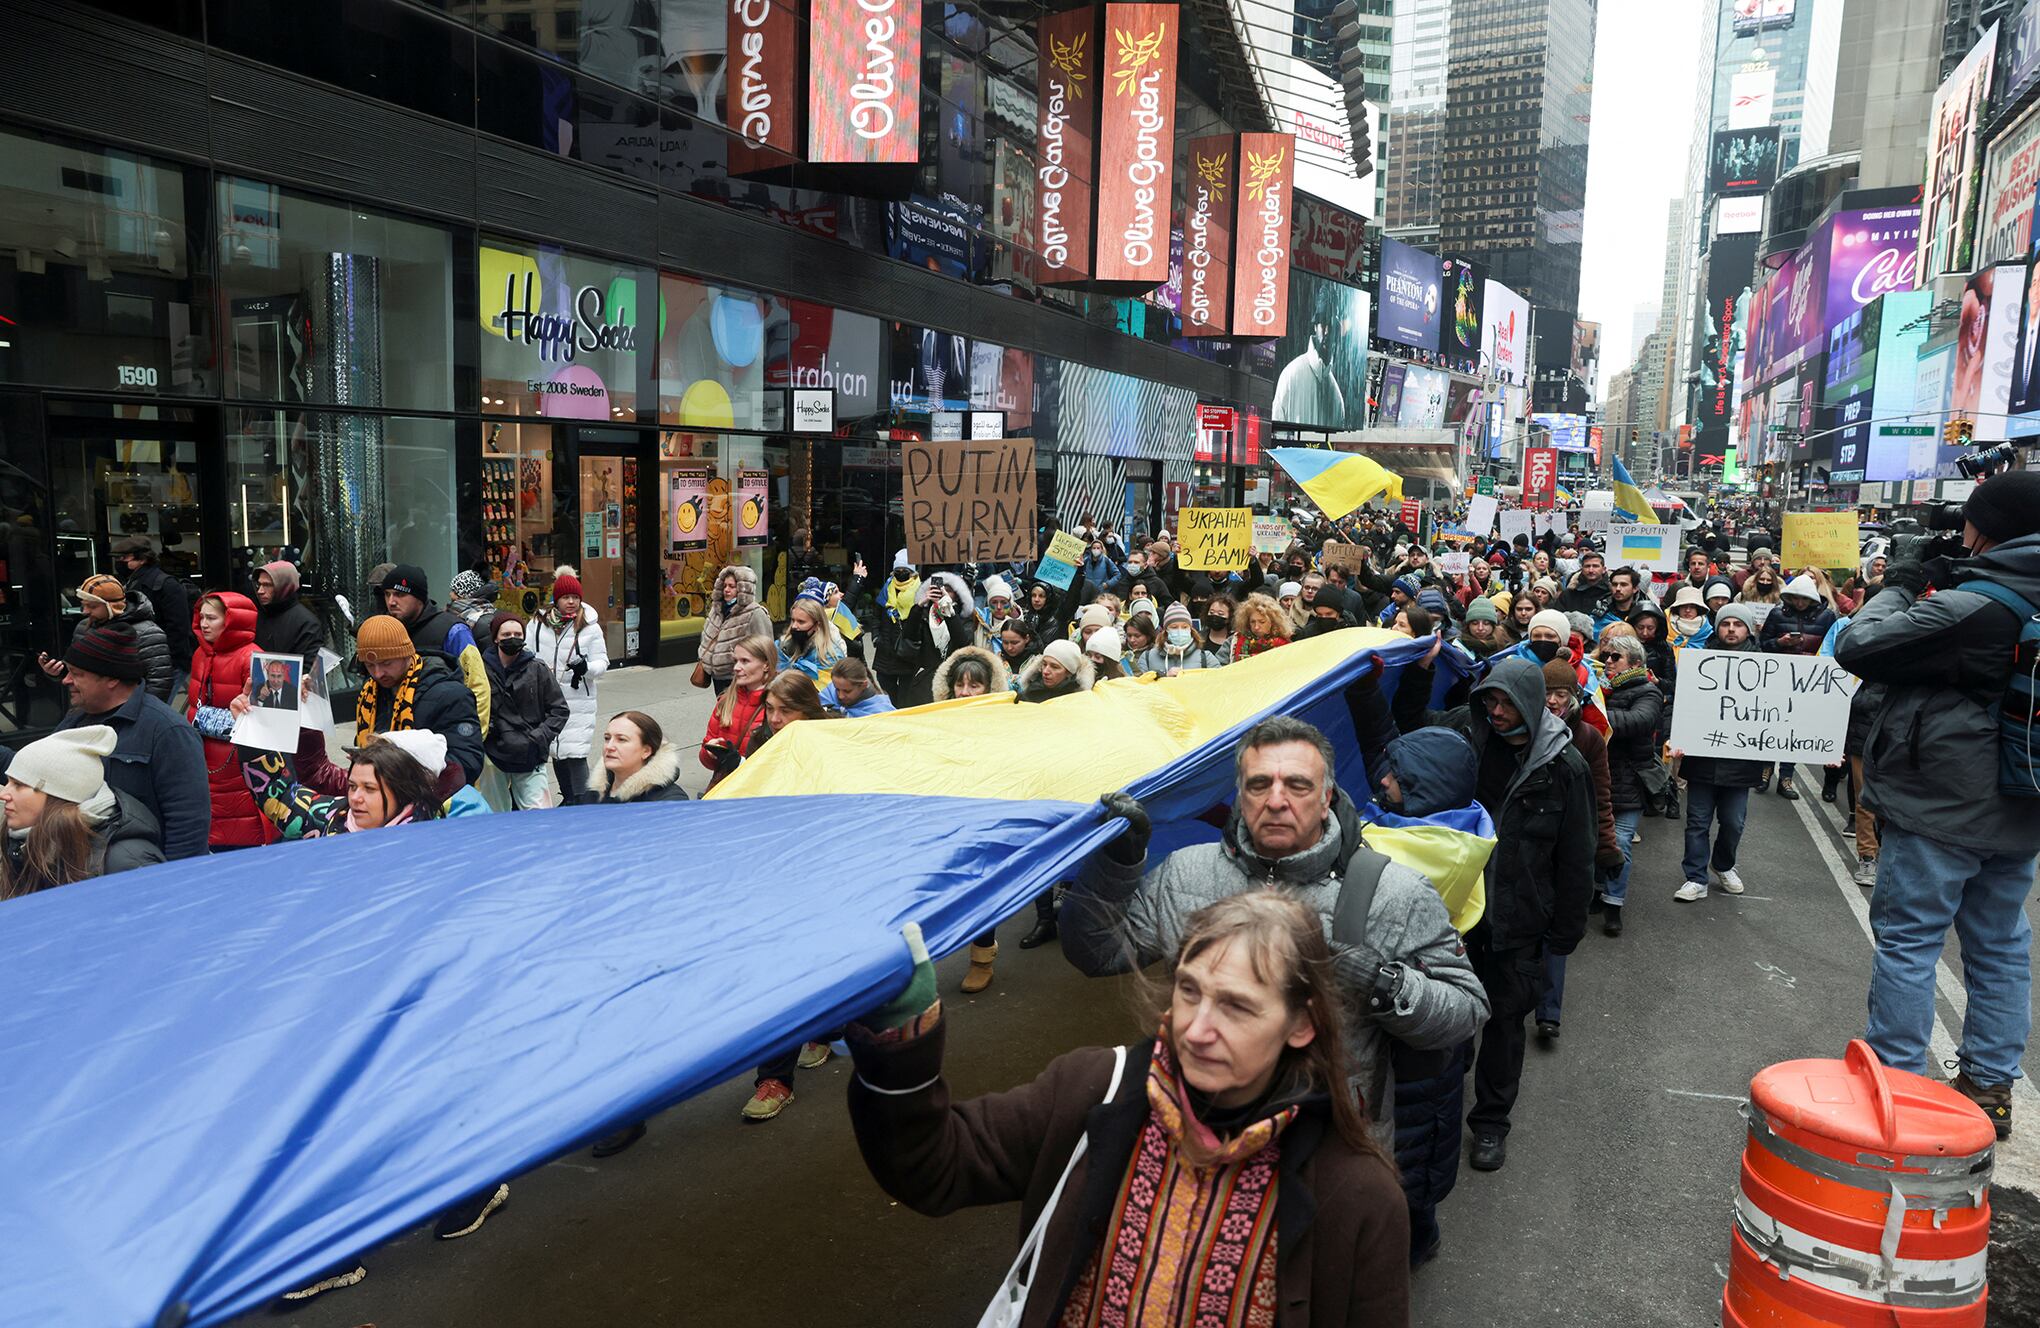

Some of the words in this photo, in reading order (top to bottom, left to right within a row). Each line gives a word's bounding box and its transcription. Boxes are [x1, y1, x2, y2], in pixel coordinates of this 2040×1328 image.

[850, 15, 895, 140] Olive
[1128, 70, 1164, 186] Garden
[1295, 111, 1345, 156] Reebok
[1124, 187, 1155, 266] Olive
[1257, 182, 1284, 266] Garden
[1253, 267, 1277, 325] Olive
[1385, 275, 1423, 302] PHANTOM
[499, 271, 578, 363] Happy
[117, 365, 158, 387] 1590
[546, 381, 568, 394] 2008
[570, 383, 605, 398] Sweden
[796, 400, 815, 416] Happy
[1844, 400, 1861, 422] PREP
[1840, 444, 1856, 464] STEP
[1187, 508, 1247, 530] УКРАЇНА
[1613, 526, 1637, 535] STOP
[921, 540, 947, 562] IN
[1199, 532, 1229, 548] МИ
[1203, 547, 1251, 567] ВАМИ
[1698, 655, 1779, 692] STOP
[1790, 662, 1848, 697] WAR
[1719, 695, 1792, 723] Putin!
